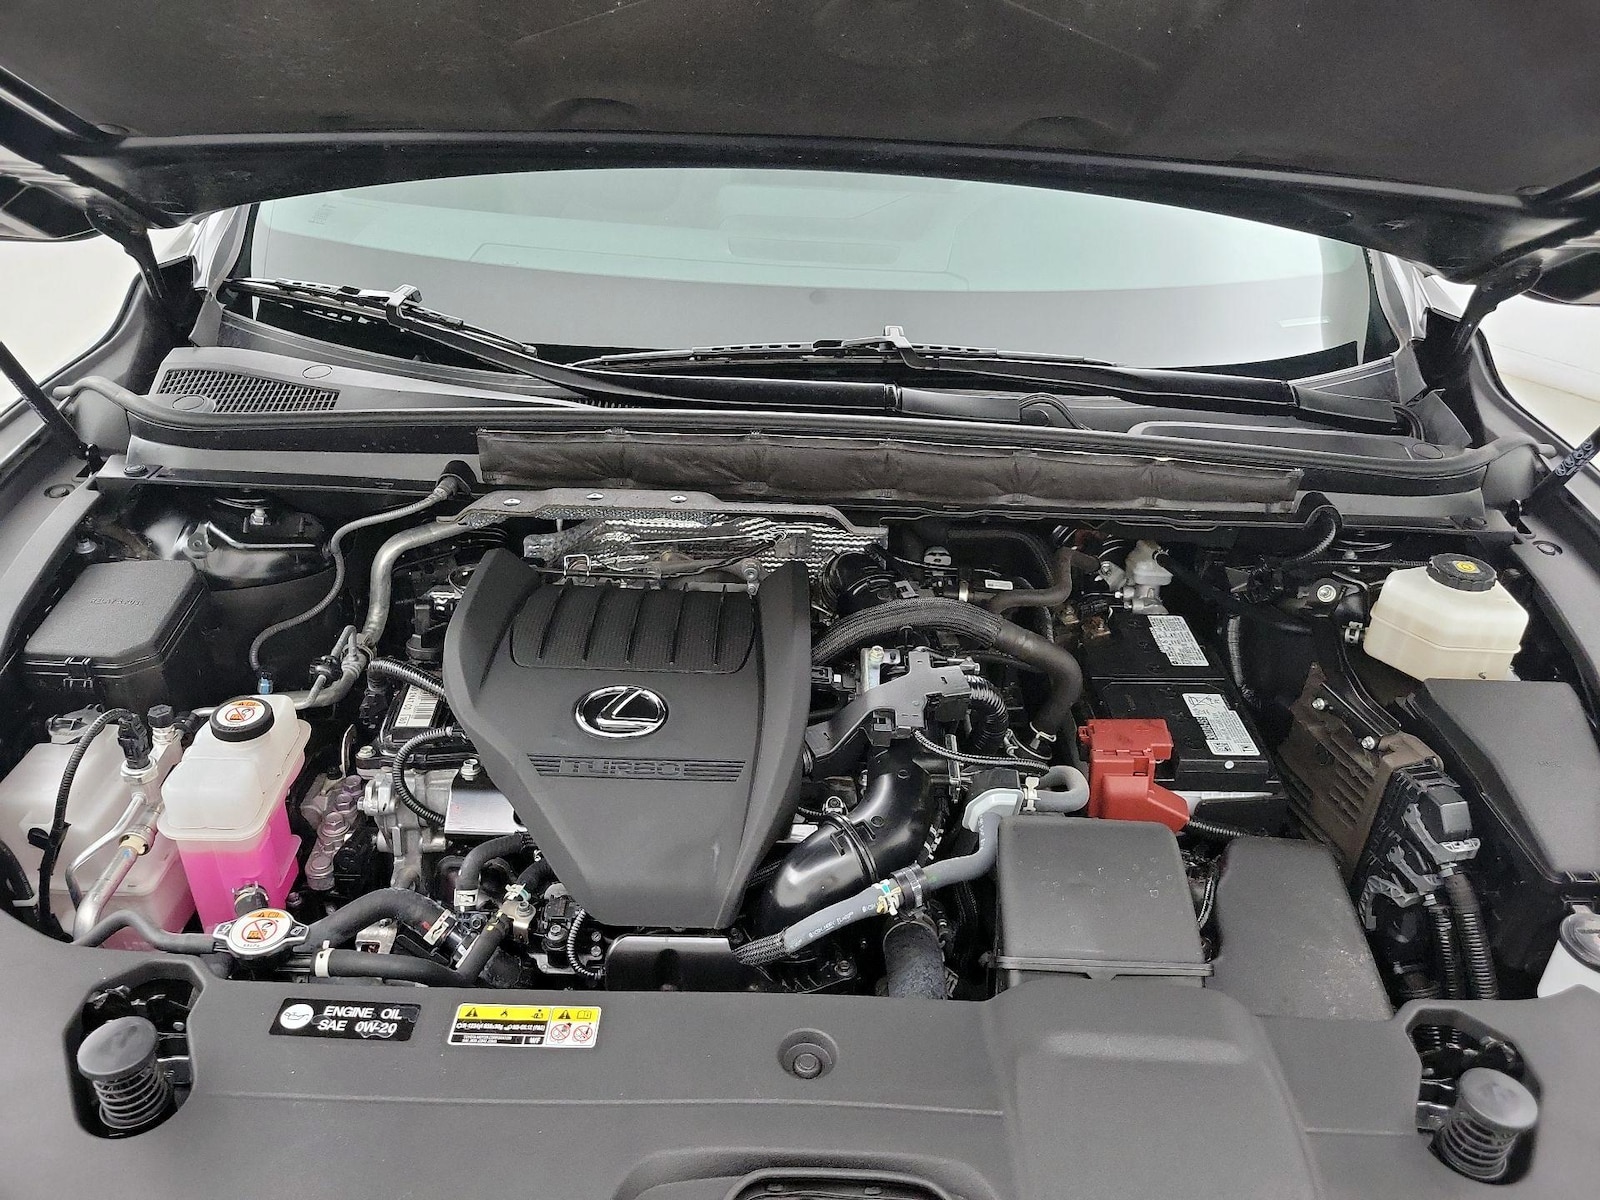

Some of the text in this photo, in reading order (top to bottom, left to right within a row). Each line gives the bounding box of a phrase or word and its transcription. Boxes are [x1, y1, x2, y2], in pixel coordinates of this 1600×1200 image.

[560, 759, 680, 776] TURBO
[323, 1005, 403, 1020] ENGINE OIL
[317, 1019, 398, 1034] SAE 0W-20
